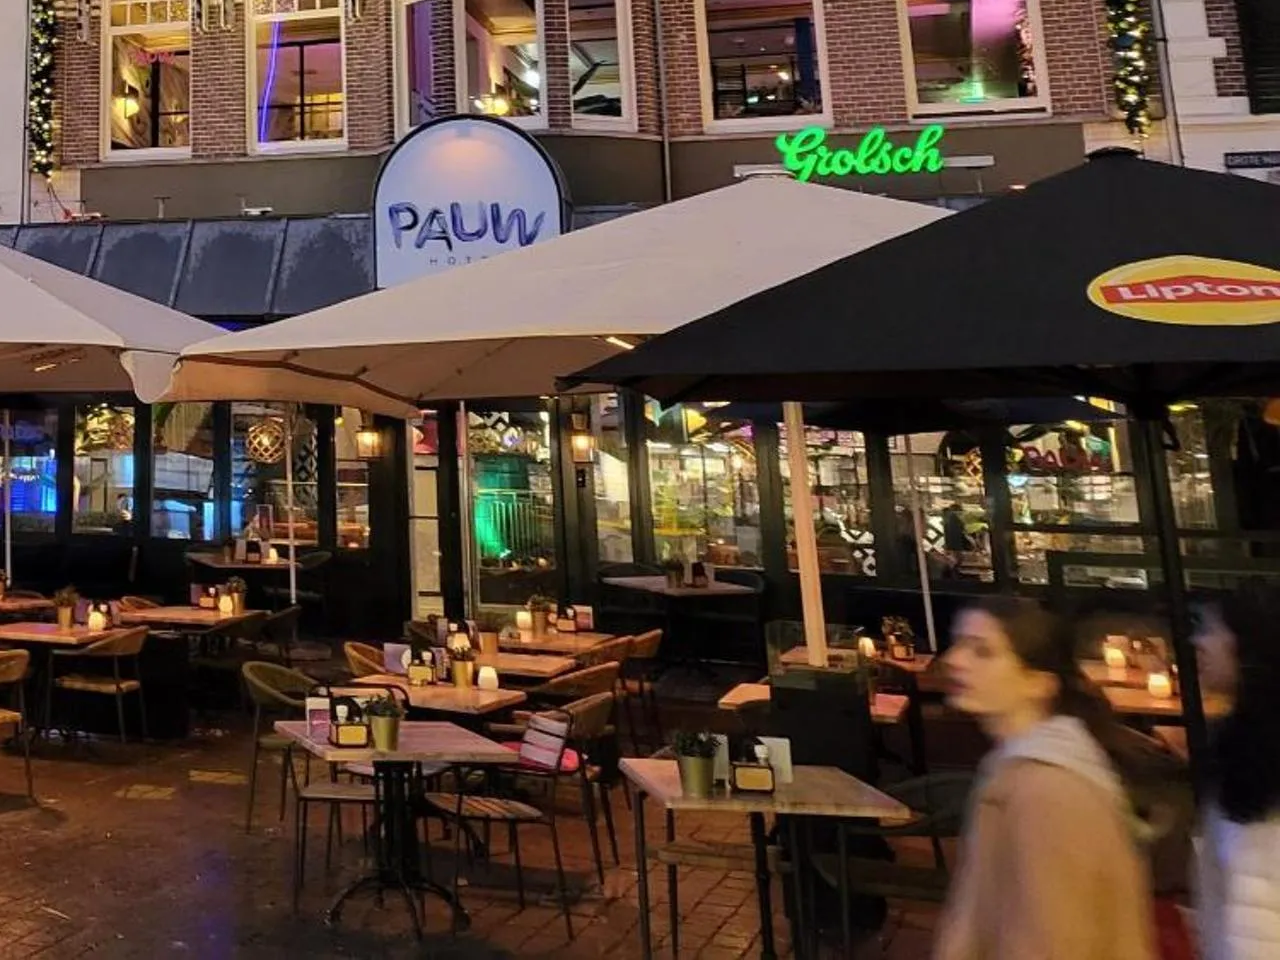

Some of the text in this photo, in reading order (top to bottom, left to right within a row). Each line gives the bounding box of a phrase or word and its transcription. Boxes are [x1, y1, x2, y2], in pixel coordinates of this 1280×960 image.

[775, 124, 944, 183] Grolsch
[388, 201, 546, 252] PAUW
[429, 255, 488, 266] HOT
[1117, 281, 1280, 302] Lipton
